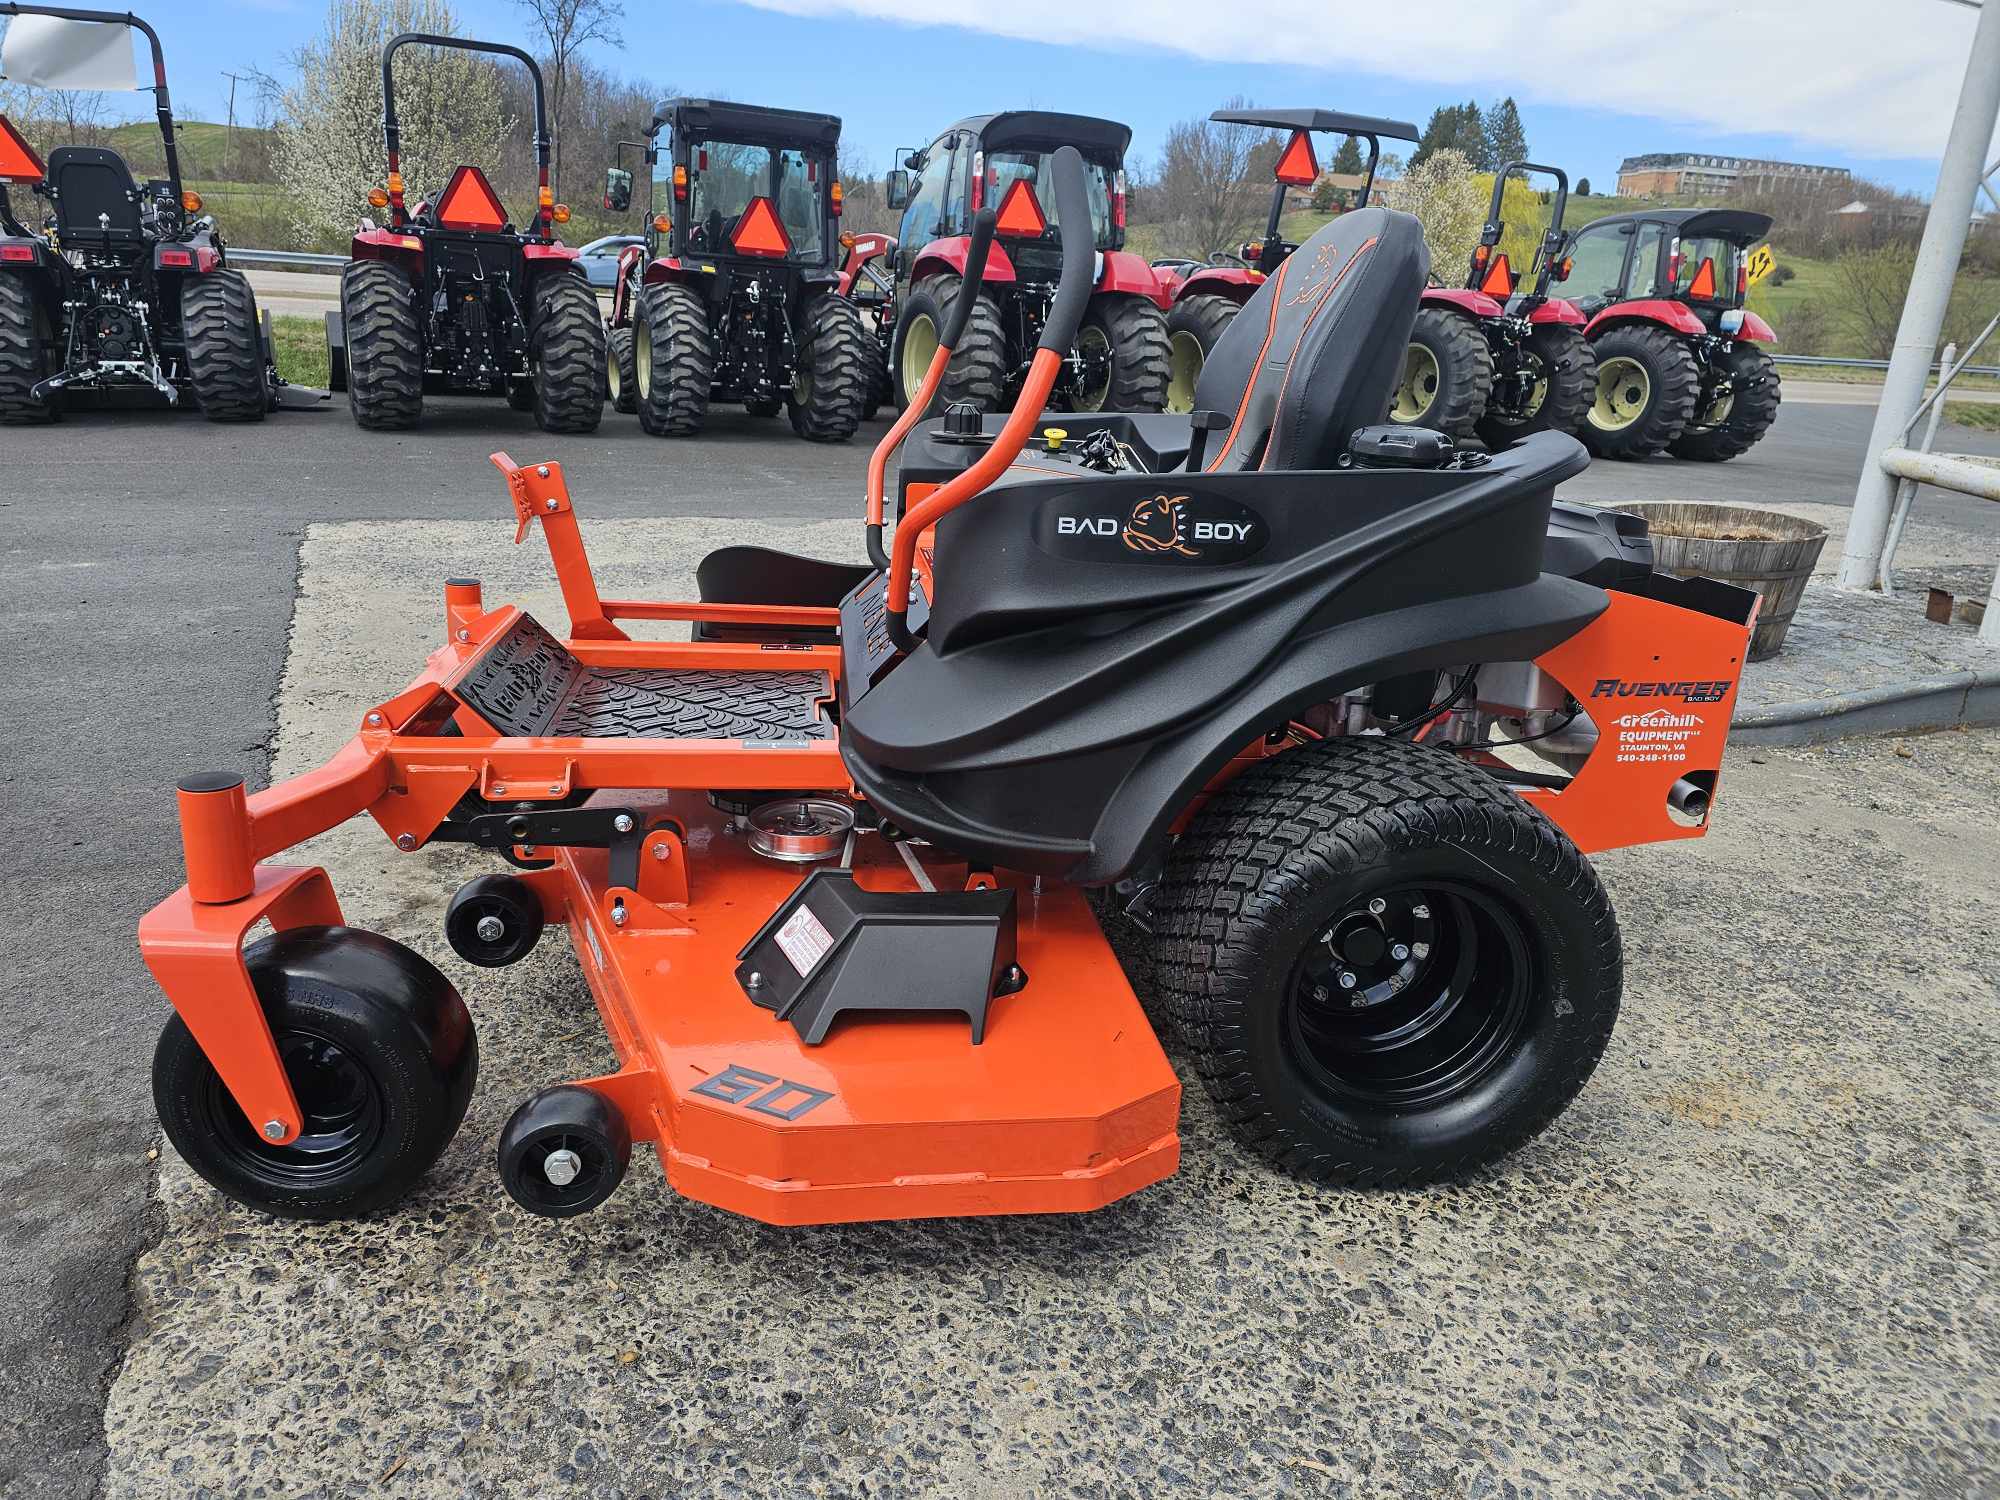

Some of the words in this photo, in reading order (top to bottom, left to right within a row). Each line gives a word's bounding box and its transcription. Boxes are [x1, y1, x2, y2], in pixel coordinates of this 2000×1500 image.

[1058, 516, 1118, 536] BAD
[1194, 522, 1253, 541] BOY
[1591, 679, 1731, 697] AVENGER
[1620, 715, 1695, 727] Greenhill
[1619, 731, 1690, 742] EQUIPMENT
[1619, 744, 1671, 752] STAUNTON,
[1616, 754, 1686, 762] 540-248-1100
[688, 1064, 835, 1121] 60
